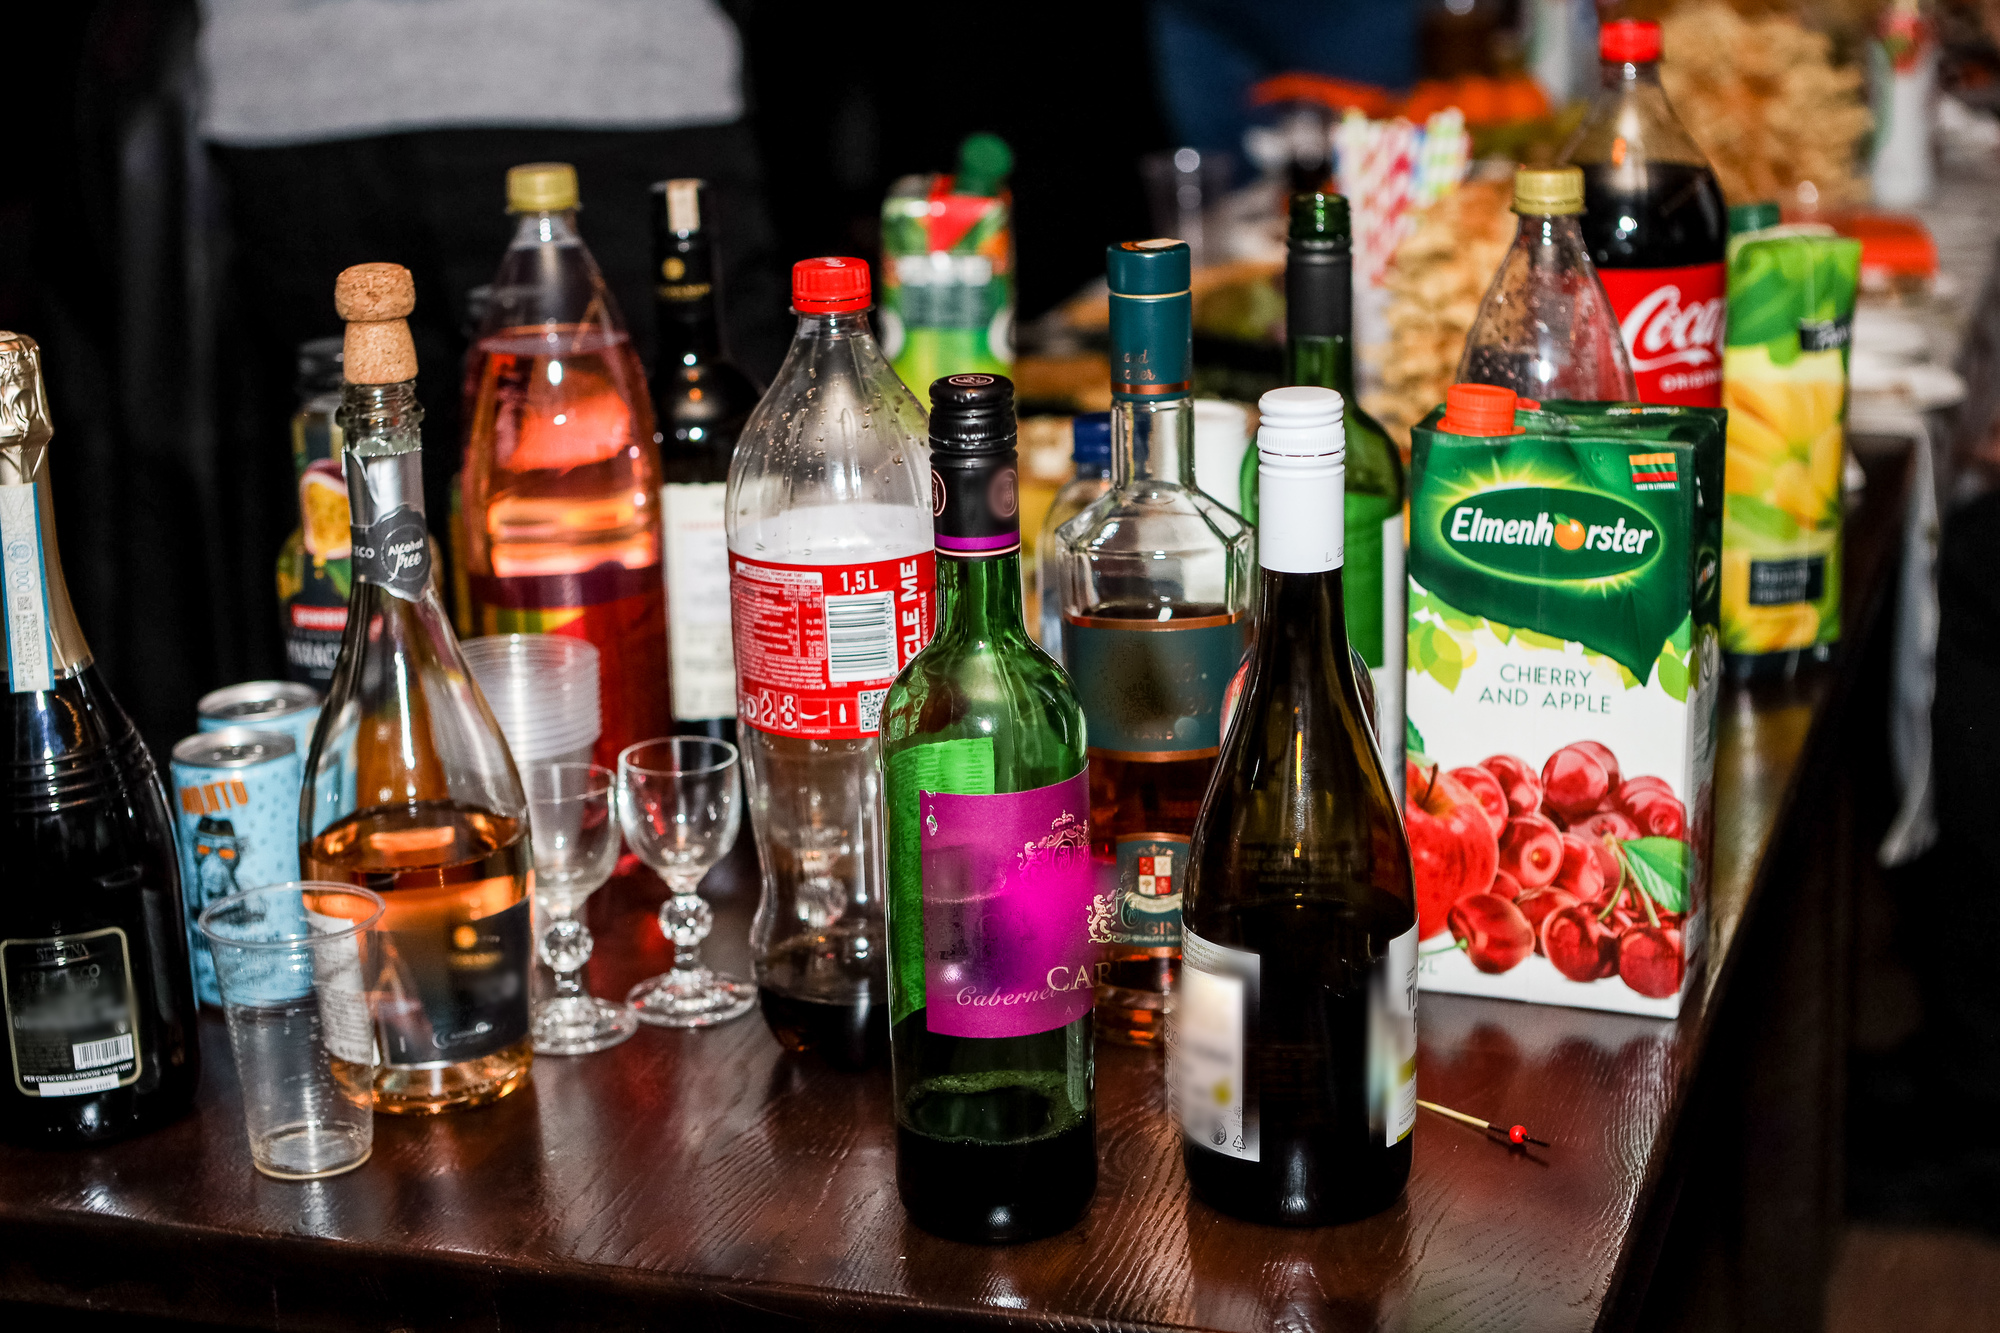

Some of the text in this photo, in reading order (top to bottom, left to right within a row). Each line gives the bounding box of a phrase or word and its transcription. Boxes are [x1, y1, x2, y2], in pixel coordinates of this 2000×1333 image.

[388, 538, 424, 557] Alcohol
[387, 546, 422, 582] free
[900, 559, 921, 664] CLE ME
[1500, 663, 1592, 688] CHERRY
[1478, 687, 1612, 714] AND APPLE
